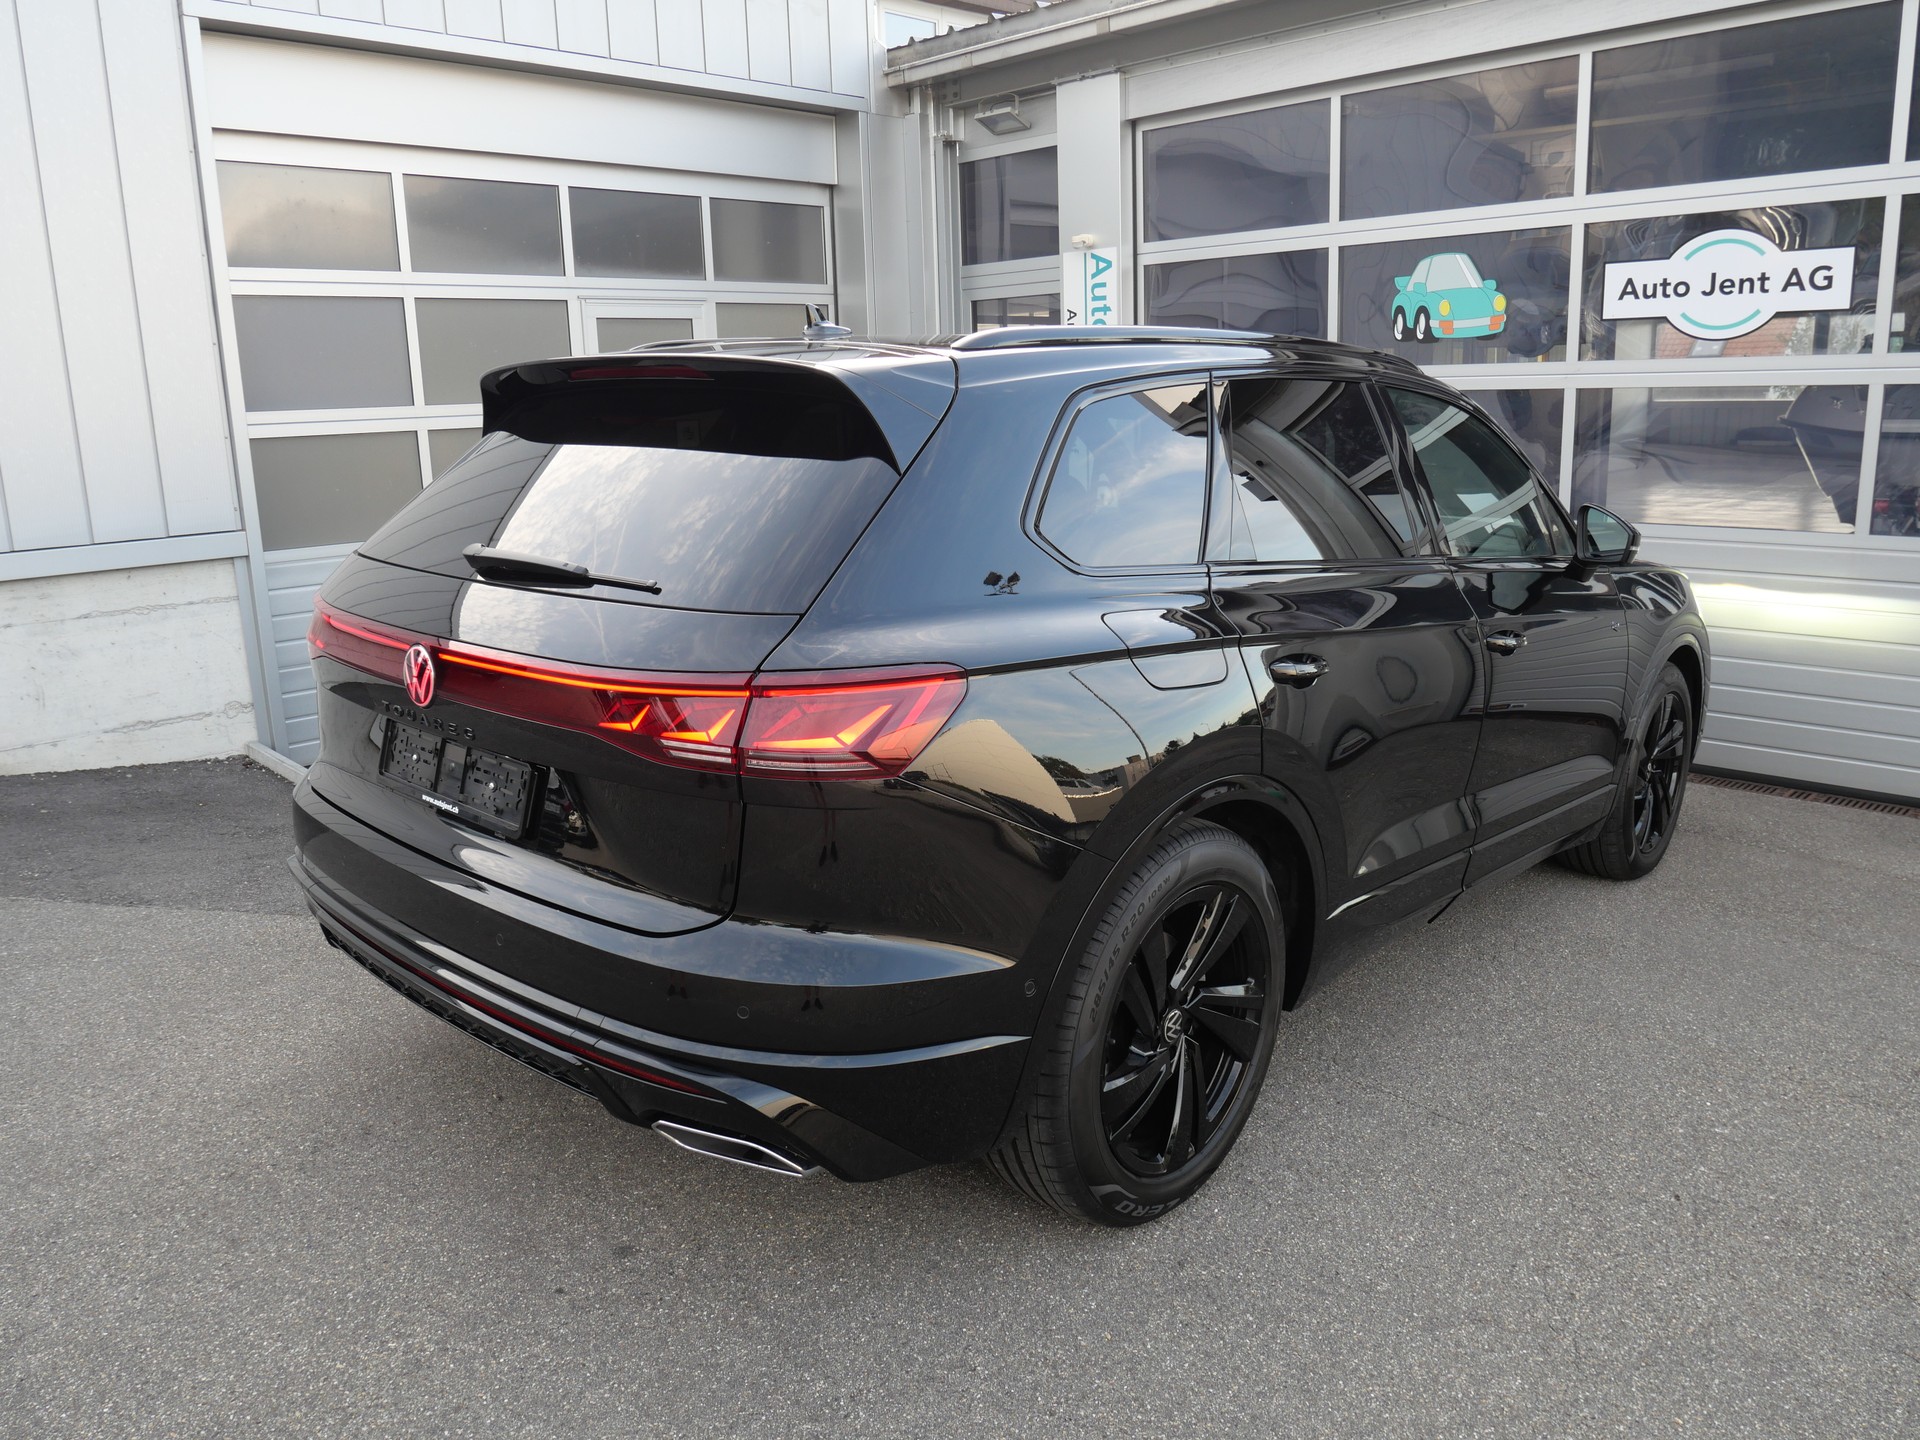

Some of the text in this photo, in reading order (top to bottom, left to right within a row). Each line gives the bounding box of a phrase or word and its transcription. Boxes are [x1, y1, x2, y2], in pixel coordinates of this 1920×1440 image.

[1617, 265, 1834, 301] Auto Jent AG
[381, 699, 476, 740] TOUAREG
